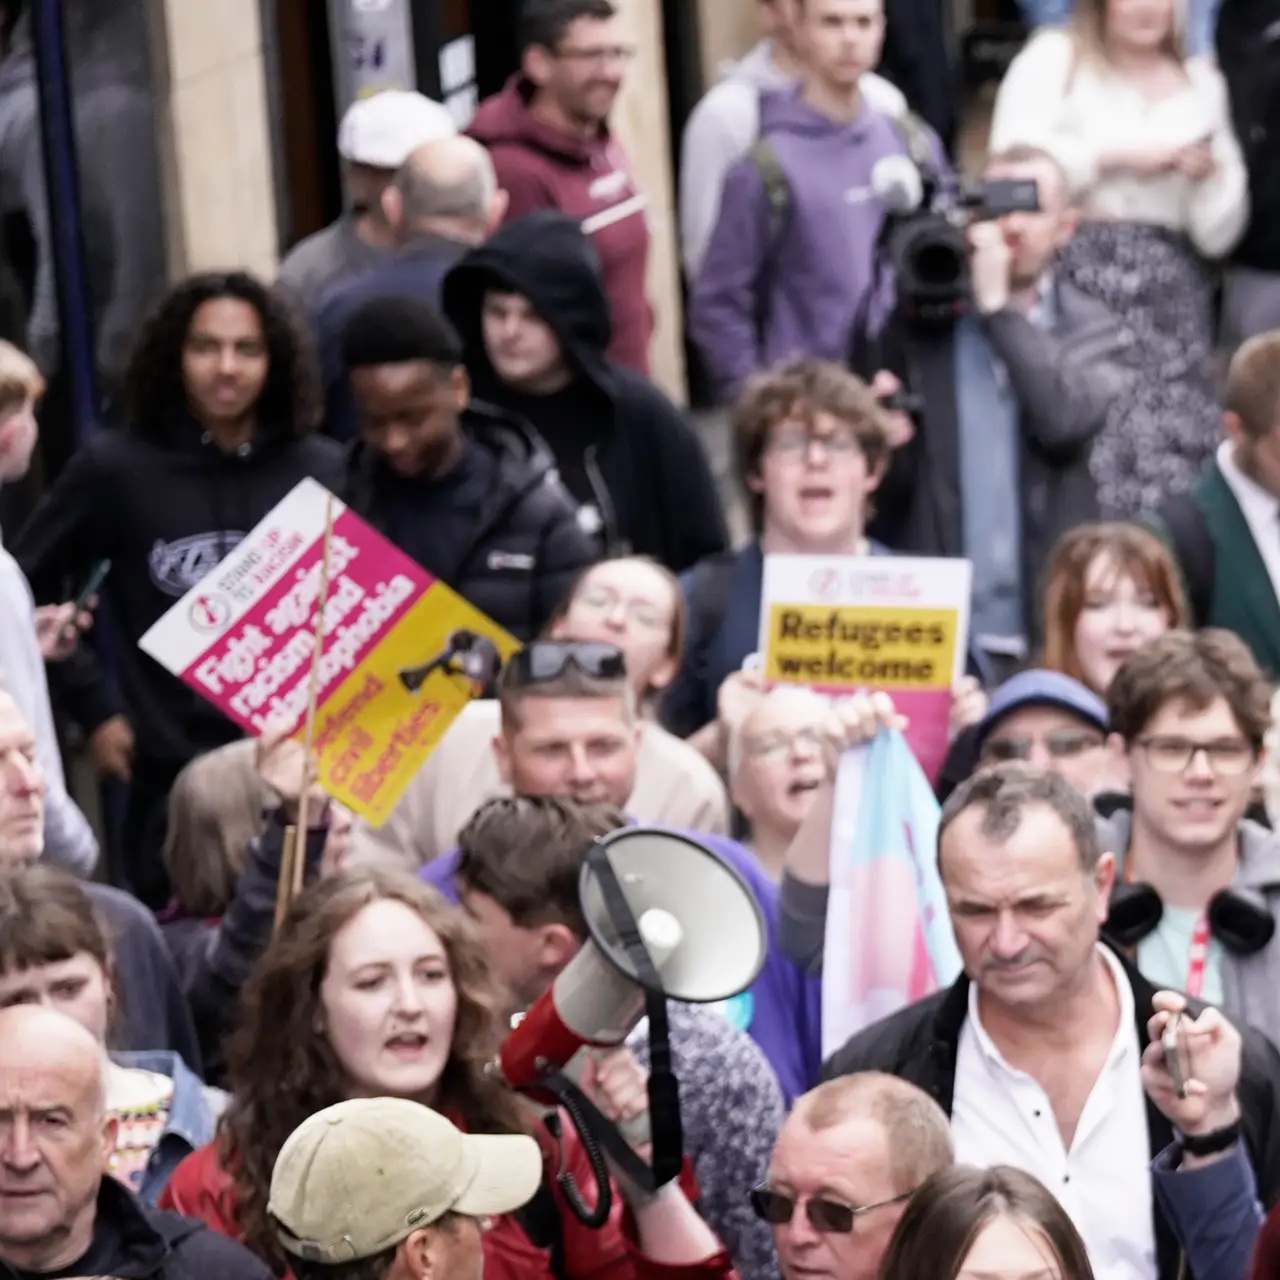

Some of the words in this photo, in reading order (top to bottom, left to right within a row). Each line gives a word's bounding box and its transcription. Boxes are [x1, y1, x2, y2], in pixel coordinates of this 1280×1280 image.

[264, 534, 360, 635] against
[194, 624, 273, 695] Fight
[229, 629, 317, 717] racism
[311, 574, 366, 637] and
[777, 651, 934, 680] welcome
[779, 610, 944, 650] Refugees
